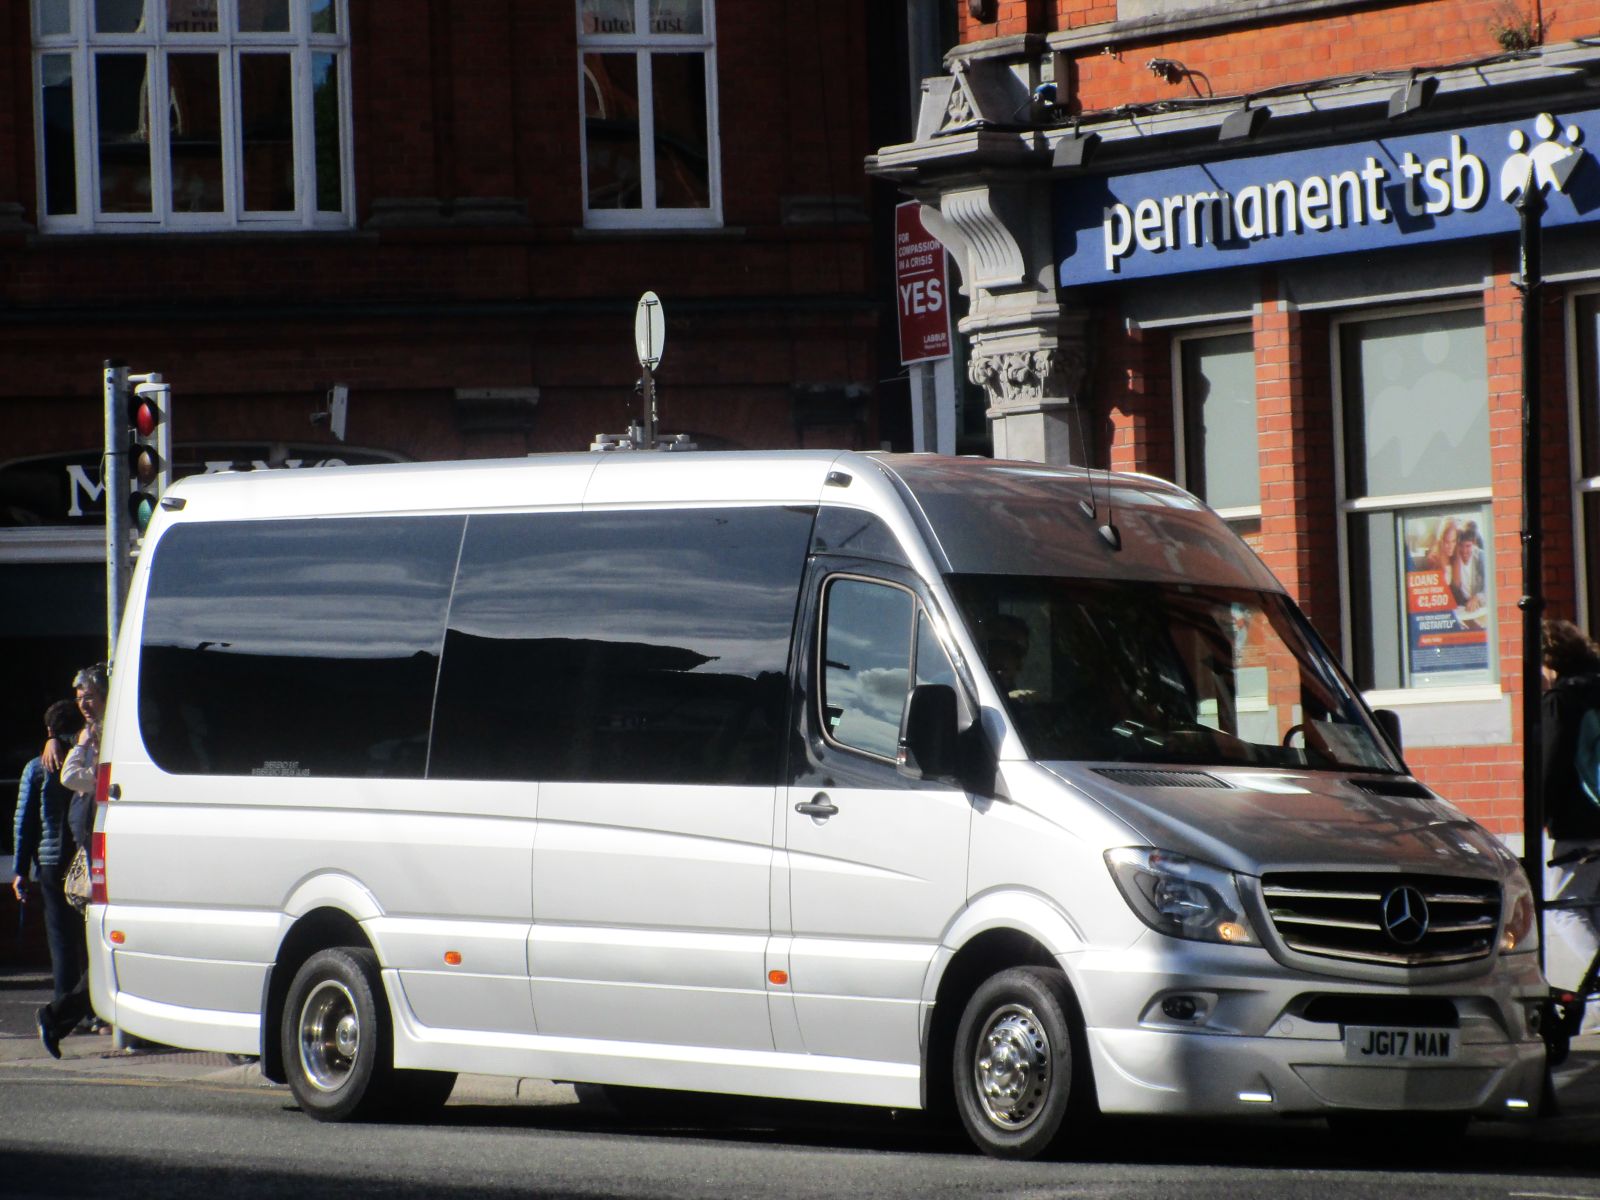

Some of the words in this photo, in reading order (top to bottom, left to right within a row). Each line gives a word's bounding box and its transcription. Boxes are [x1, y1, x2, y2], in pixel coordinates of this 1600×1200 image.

[1103, 157, 1387, 271] permanent
[1400, 134, 1484, 218] tsb
[898, 232, 910, 244] FOR
[898, 239, 941, 257] COMPASSION
[910, 254, 933, 268] CRISIS
[900, 278, 943, 316] YES
[1409, 573, 1439, 588] LOANS
[1361, 1031, 1409, 1056] JG17
